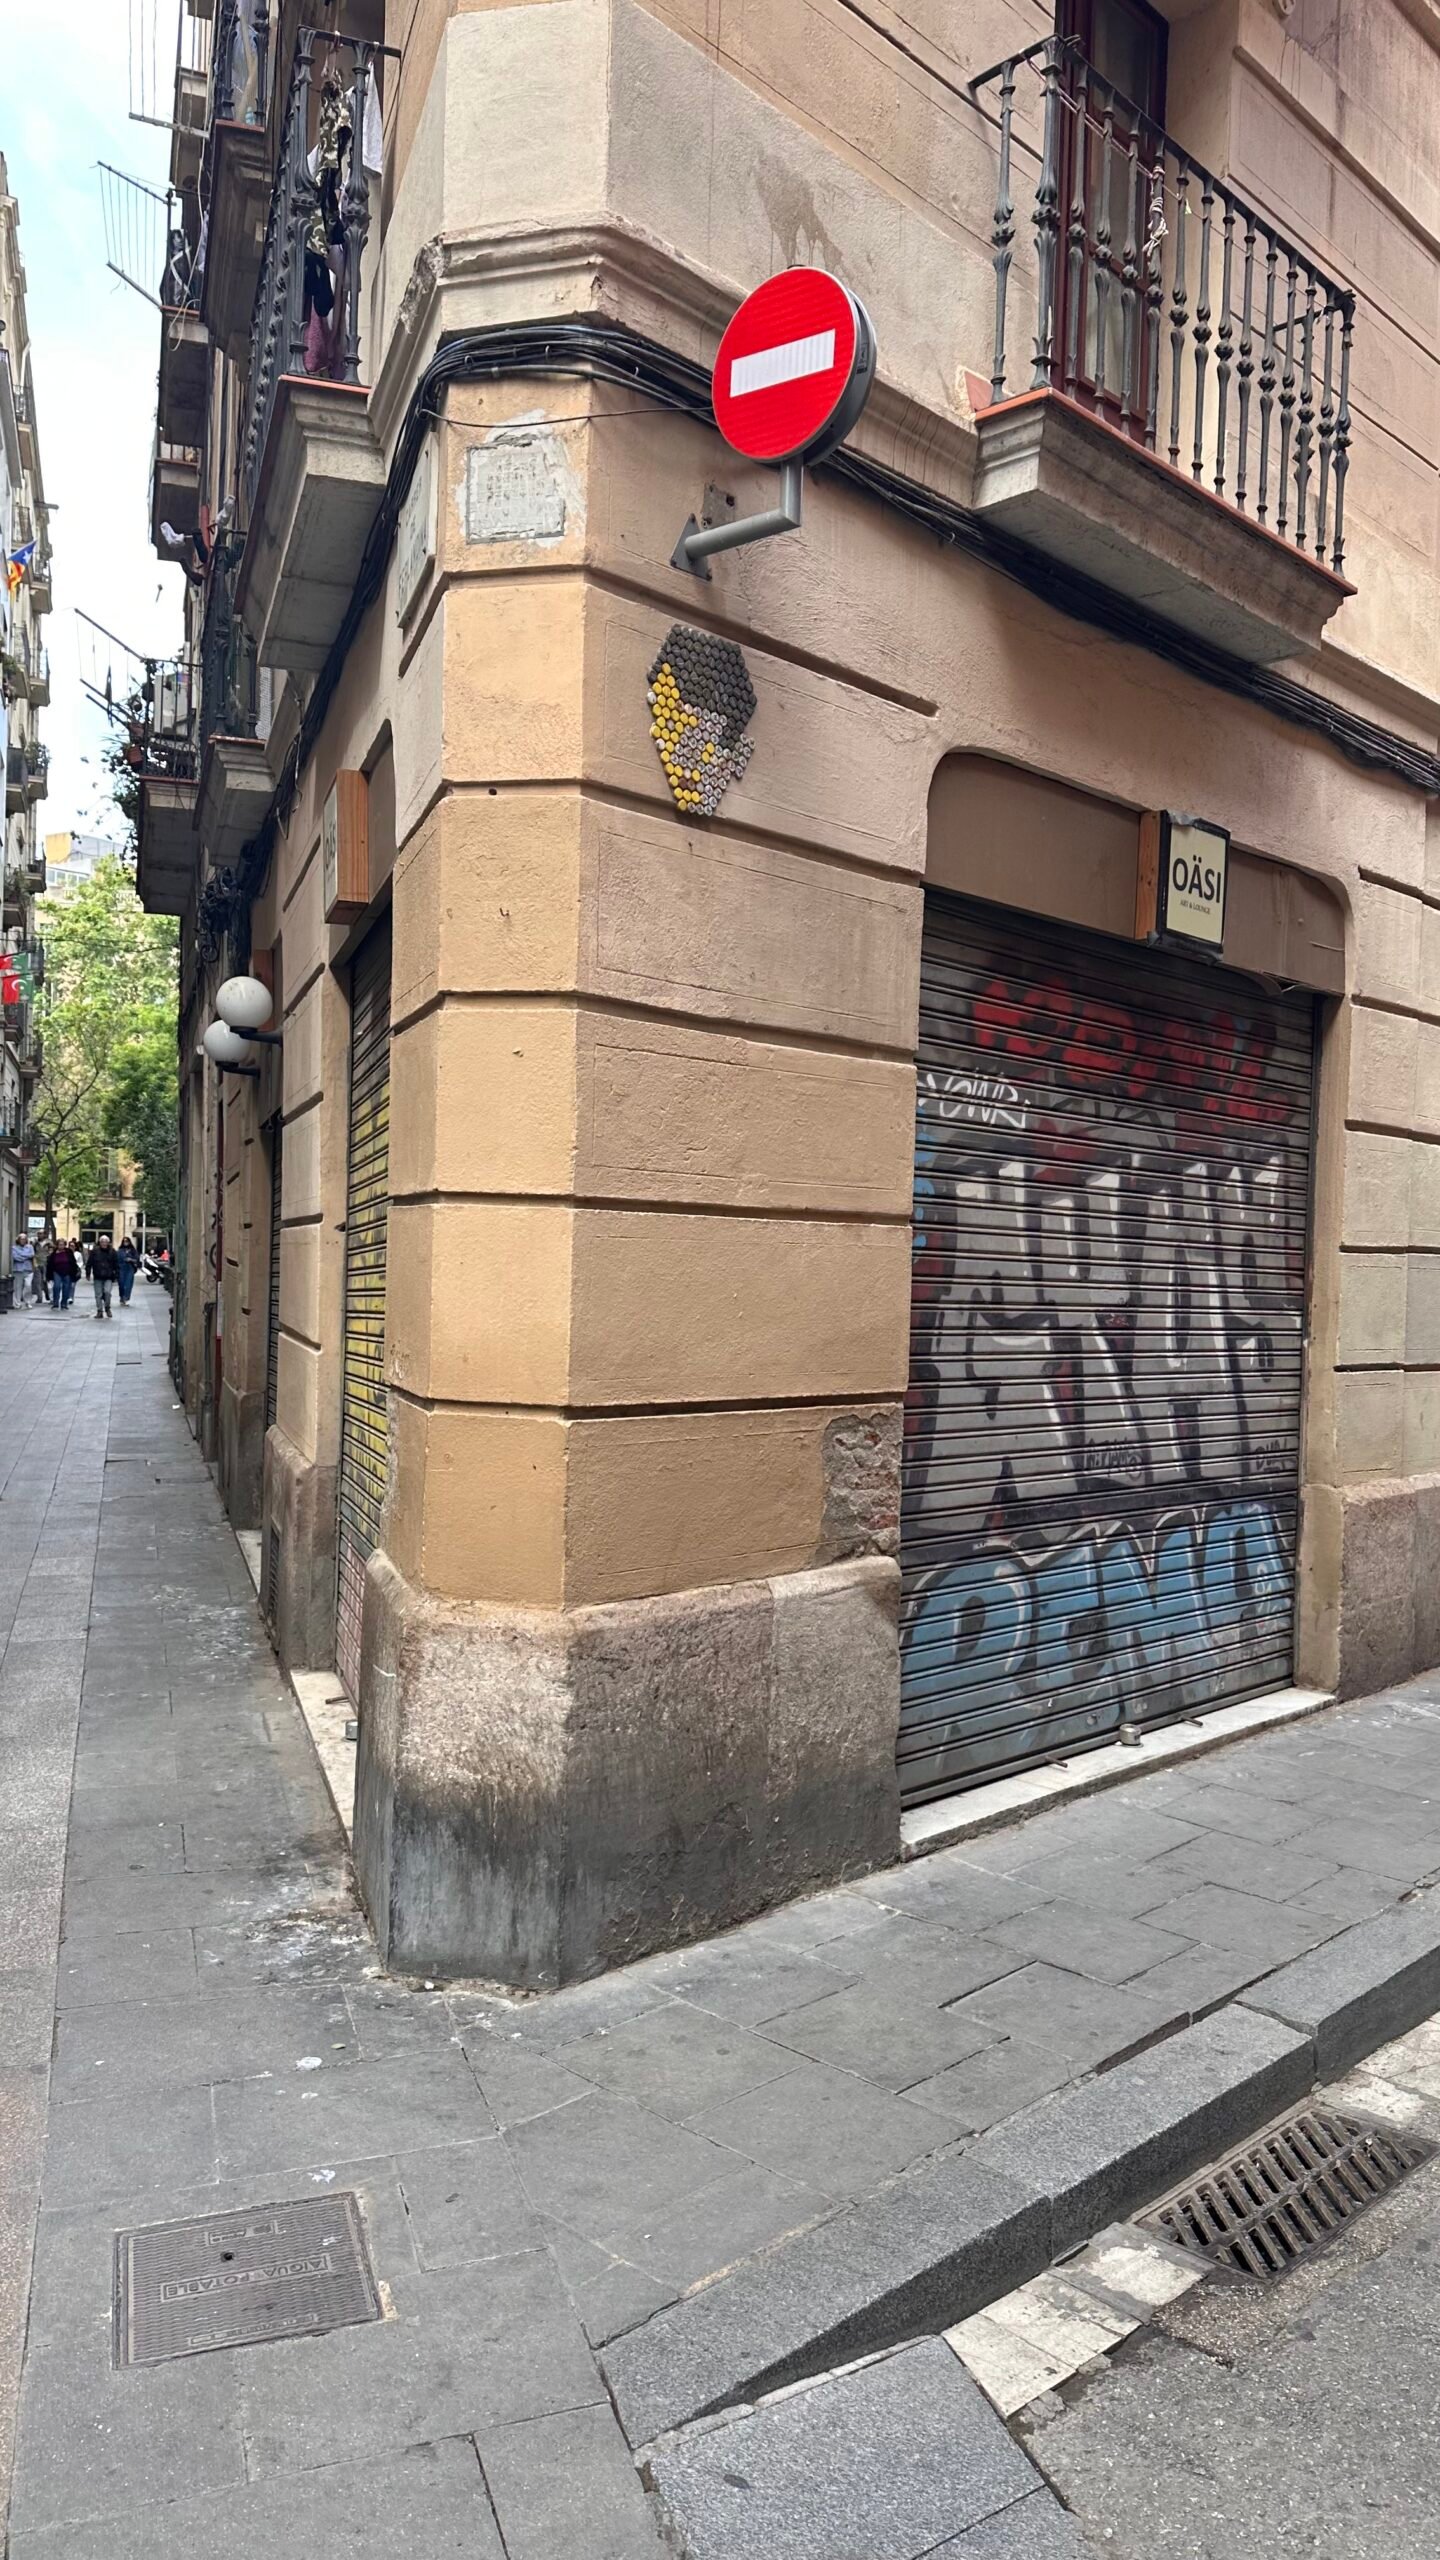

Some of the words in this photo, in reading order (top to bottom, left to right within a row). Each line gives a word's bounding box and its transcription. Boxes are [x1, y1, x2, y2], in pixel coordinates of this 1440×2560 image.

[1173, 855, 1221, 903] OÄSI
[263, 2259, 323, 2277] AIGUA
[168, 2273, 250, 2296] POTABLE
